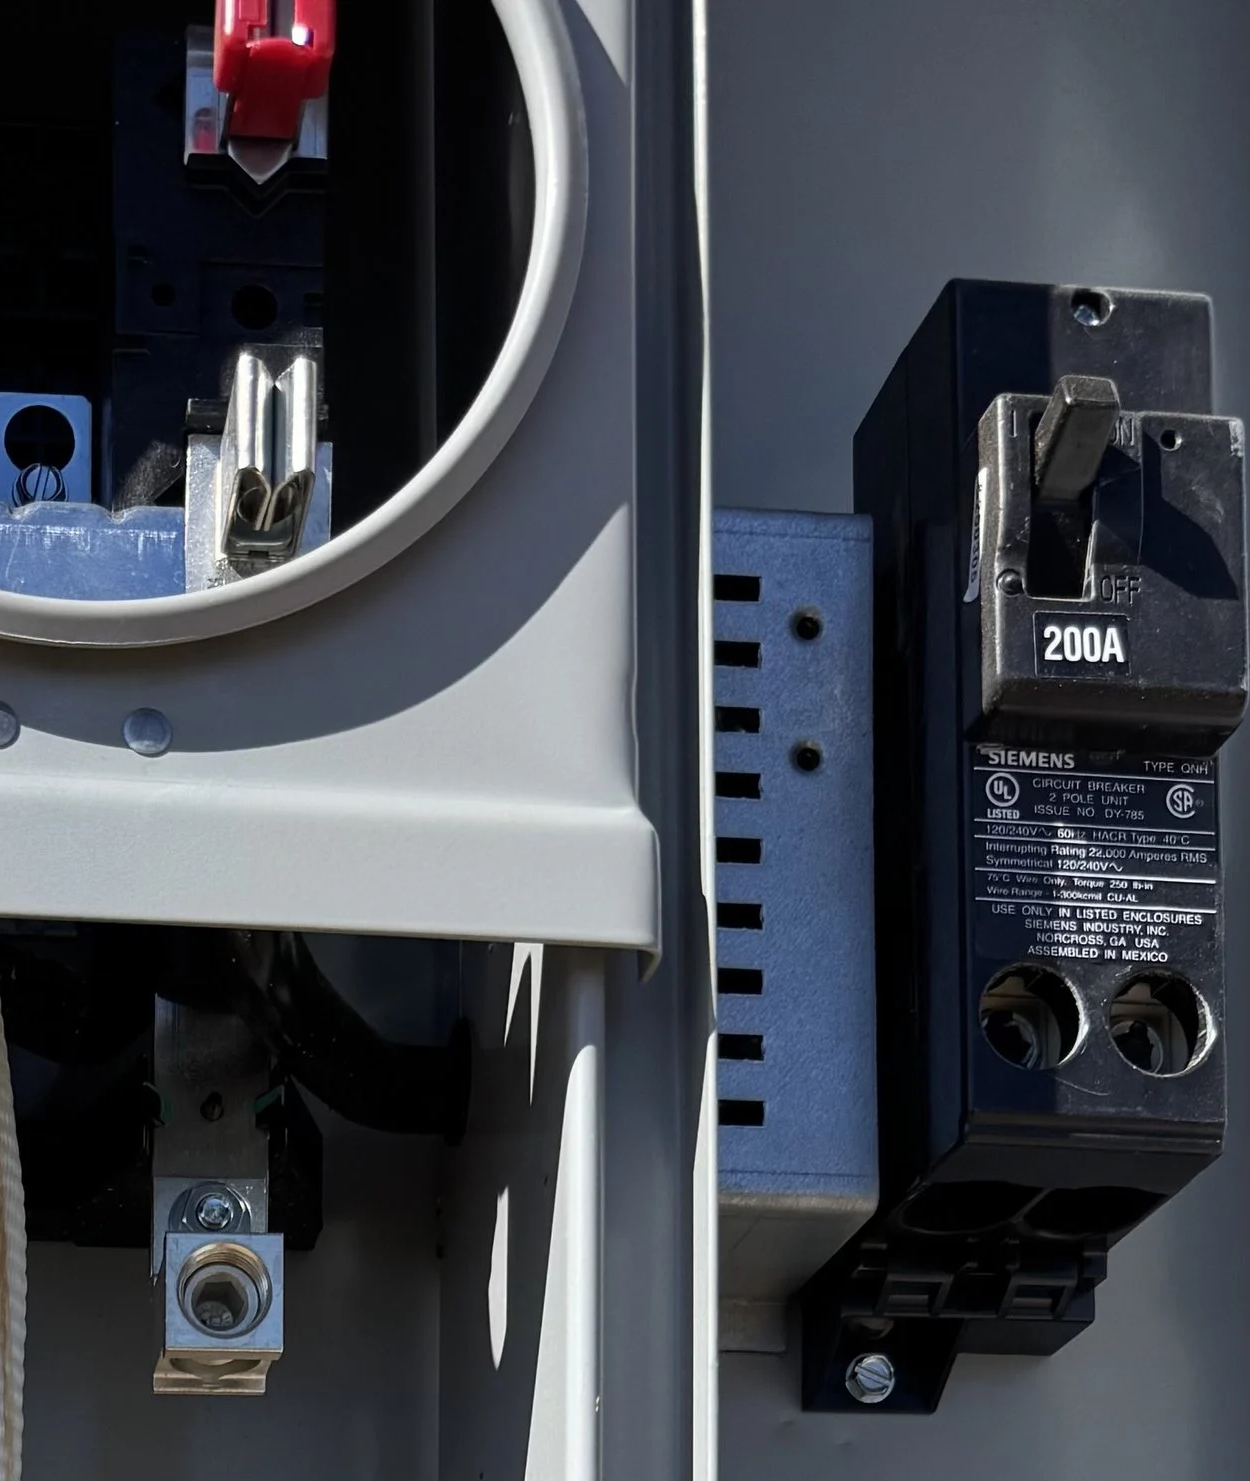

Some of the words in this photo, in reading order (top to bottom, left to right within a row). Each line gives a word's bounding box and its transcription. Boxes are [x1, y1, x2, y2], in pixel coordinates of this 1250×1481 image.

[1101, 575, 1141, 605] OFF
[1043, 626, 1125, 663] 200A
[988, 750, 1075, 769] SIEMENS
[1143, 761, 1175, 773] TYPE
[1032, 778, 1081, 790] CIRCUIT
[1088, 781, 1145, 794] BREAKER
[1049, 792, 1057, 802] 2
[1063, 794, 1094, 805] POLE
[1101, 796, 1129, 806] UNIT
[987, 808, 1020, 820] LISTED
[1034, 804, 1070, 816] ISSUE
[1105, 809, 1145, 820] DY-785
[1092, 831, 1127, 841] HACR
[1131, 833, 1156, 845] Type
[985, 841, 1047, 856] Interrupting
[1050, 844, 1086, 858] Rating
[1128, 849, 1177, 862] Amperes
[1180, 852, 1207, 863] RMS
[986, 854, 1053, 868] Symmetrical
[1016, 874, 1039, 883] Wire
[1072, 877, 1104, 889] Torque
[1109, 880, 1128, 889] 250
[986, 886, 1009, 895] Wire
[1011, 887, 1043, 897] Range
[991, 904, 1016, 915] USE
[1021, 905, 1053, 917] ONLY
[1058, 907, 1070, 918] IN
[1076, 908, 1117, 920] LISTED
[1123, 911, 1203, 925] ENCLOSURES
[1025, 918, 1077, 931] SIEMENS
[1146, 925, 1169, 936] INC.
[1109, 936, 1126, 947] GA
[1134, 938, 1159, 949] USA
[1027, 945, 1098, 958] ASSEMBLED
[1104, 949, 1116, 960] IN
[1121, 950, 1168, 963] MEXICO
